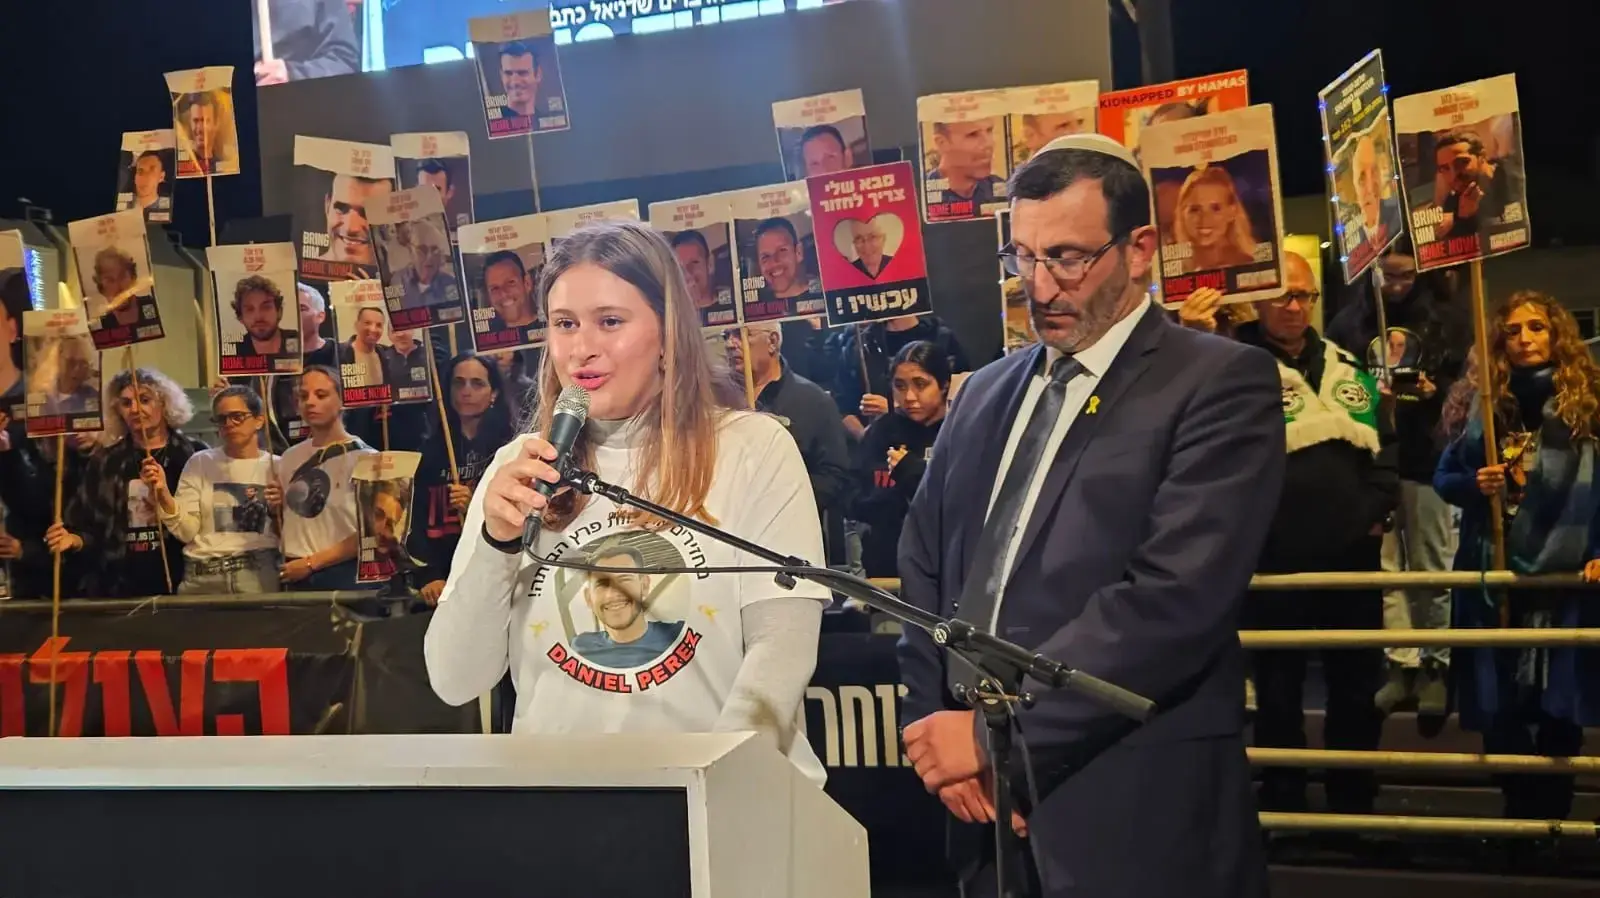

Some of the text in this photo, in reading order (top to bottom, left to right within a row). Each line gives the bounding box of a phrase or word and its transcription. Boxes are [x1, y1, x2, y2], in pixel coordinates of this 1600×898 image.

[1100, 75, 1245, 109] KIDNAPPED BY HAMAS
[824, 174, 895, 196] סבא שלי
[820, 188, 906, 212] צריך לחזור
[1412, 206, 1444, 228] BRING
[303, 231, 330, 247] BRING
[1415, 226, 1436, 245] HIM
[303, 245, 320, 259] HIM
[1419, 241, 1447, 261] HOME
[743, 276, 765, 291] BRING
[744, 289, 759, 302] HIM
[848, 288, 918, 314] עכשיו
[473, 307, 496, 321] BRING
[341, 363, 366, 376] BRING
[342, 376, 365, 388] THEM
[343, 388, 368, 401] HOME
[368, 384, 392, 400] NOW!
[568, 521, 602, 545] פרץ
[527, 541, 569, 598] הבתה!
[547, 627, 702, 693] DANIEL PEREZ
